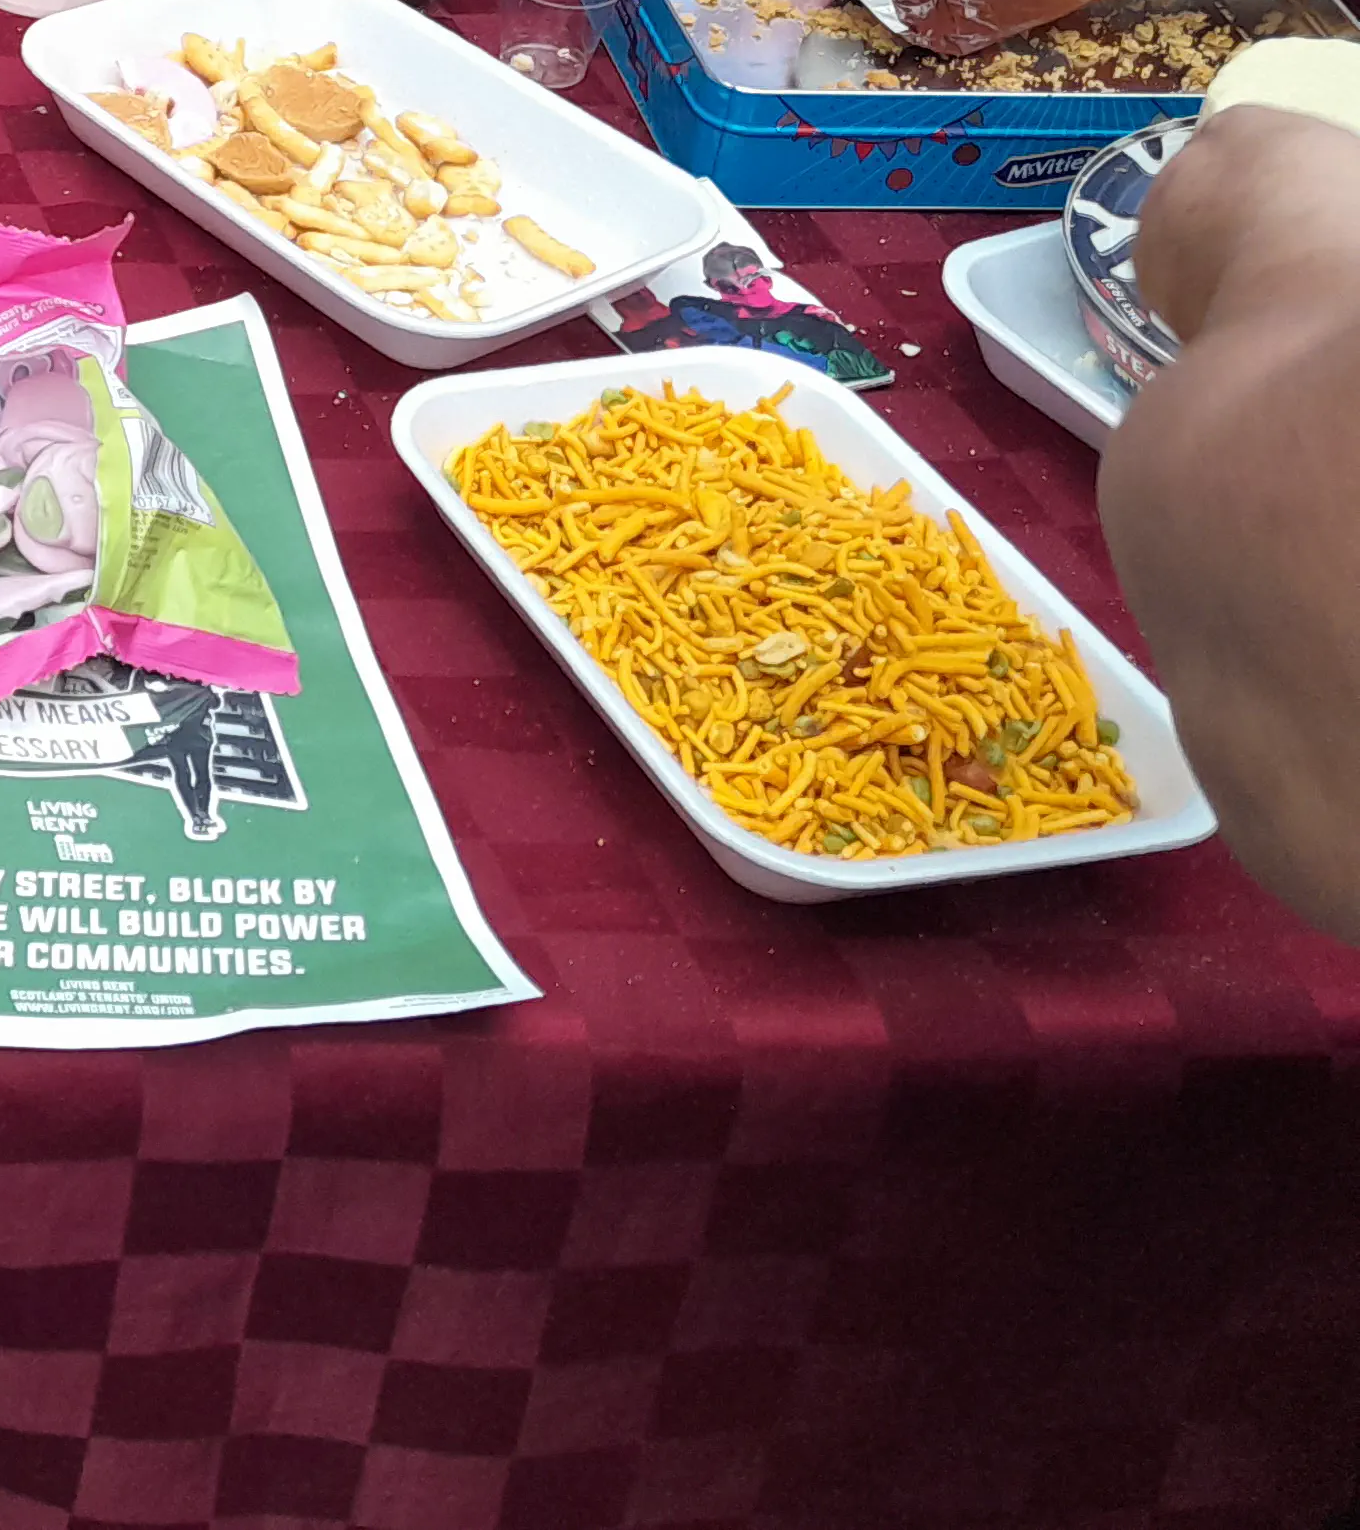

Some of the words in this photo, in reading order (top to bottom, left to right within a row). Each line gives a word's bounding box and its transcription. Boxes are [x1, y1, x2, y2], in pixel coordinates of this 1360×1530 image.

[37, 700, 131, 726] MEANS
[26, 800, 98, 819] LIVING
[30, 817, 89, 834] RENT
[15, 869, 157, 906] STREET,
[168, 877, 283, 905] BLOCK
[293, 879, 338, 907] BY
[20, 905, 110, 938] WILL
[118, 909, 223, 939] BUILD
[235, 912, 367, 942] POWER
[26, 942, 306, 976] COMMUNITIES.
[59, 979, 102, 991] LIVING
[102, 980, 136, 992] RENT
